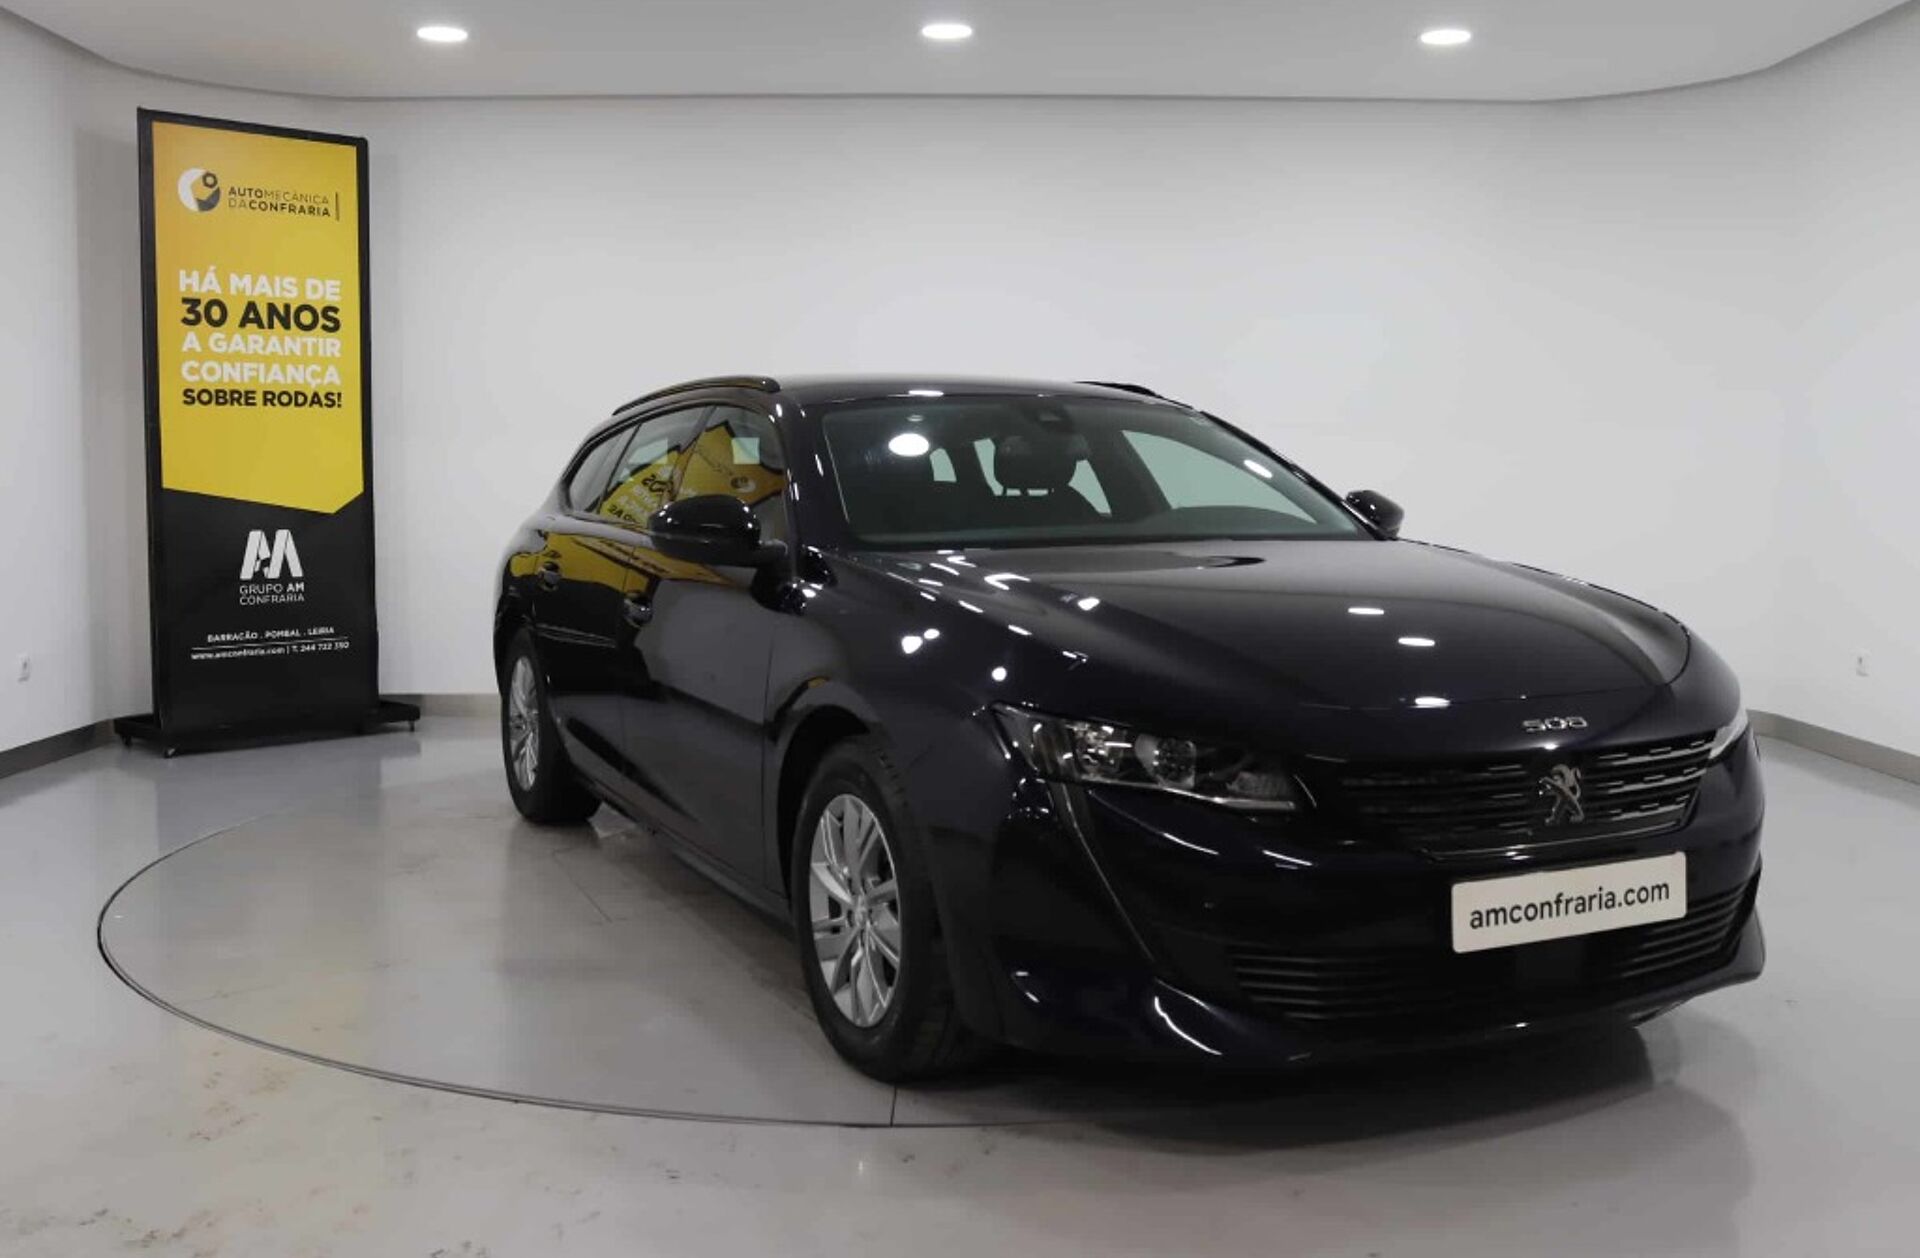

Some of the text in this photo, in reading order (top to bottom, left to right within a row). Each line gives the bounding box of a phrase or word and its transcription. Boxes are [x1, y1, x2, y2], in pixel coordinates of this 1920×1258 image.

[179, 266, 341, 301] HÁ MAIS DE
[181, 297, 341, 333] 30 ANOS
[181, 331, 341, 358] A GARANTIR
[181, 359, 341, 388] CONFIANÇA
[182, 388, 342, 408] SOBRE RODAS!
[240, 581, 305, 595] GRUPO AM
[240, 593, 305, 606] CONFRARIA
[1469, 881, 1670, 930] amconfraria.com
